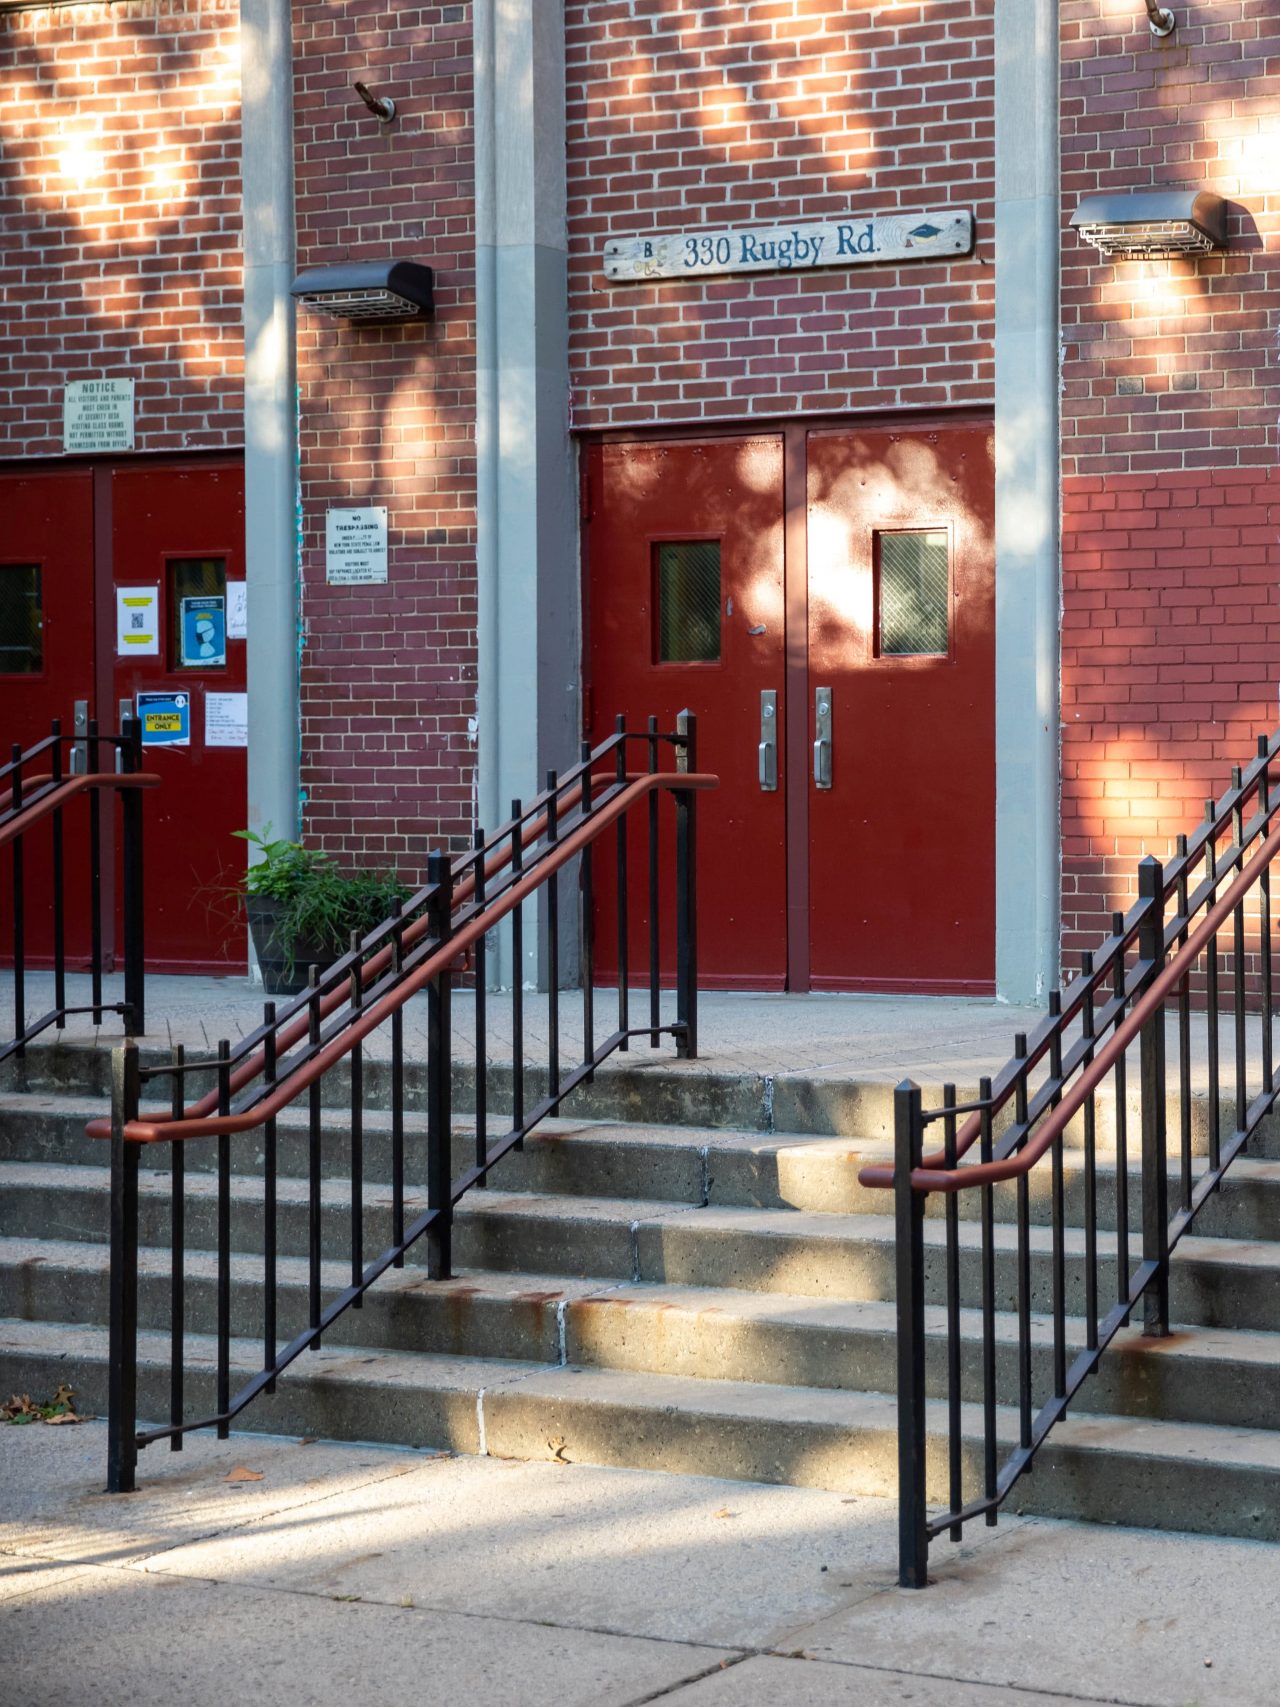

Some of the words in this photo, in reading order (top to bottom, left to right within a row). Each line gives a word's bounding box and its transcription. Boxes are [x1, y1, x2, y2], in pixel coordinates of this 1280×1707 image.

[684, 237, 731, 268] 330
[739, 230, 825, 269] Rugby
[836, 224, 881, 255] Rd.
[82, 383, 115, 393] NOTICE
[146, 714, 180, 722] ENTRANCE
